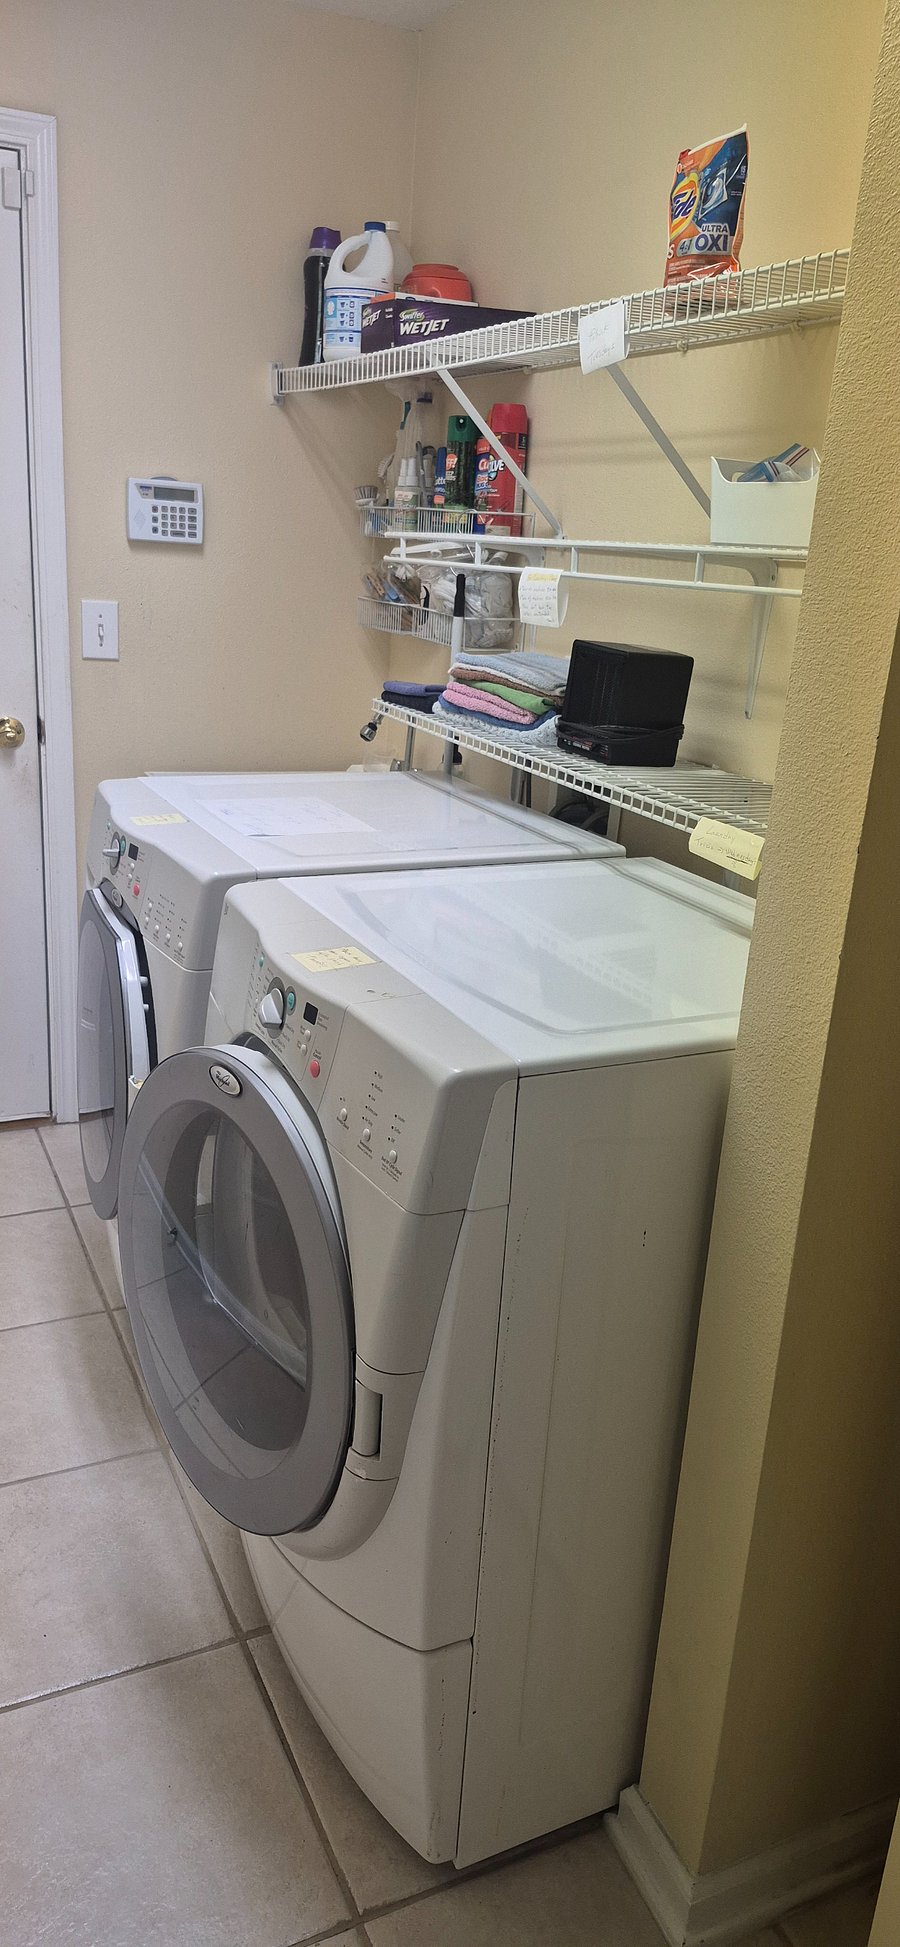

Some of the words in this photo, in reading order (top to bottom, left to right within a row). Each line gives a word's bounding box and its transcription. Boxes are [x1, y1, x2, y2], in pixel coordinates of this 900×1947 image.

[701, 224, 729, 233] ULTRA
[695, 233, 729, 252] OXI
[400, 319, 449, 336] WETJET
